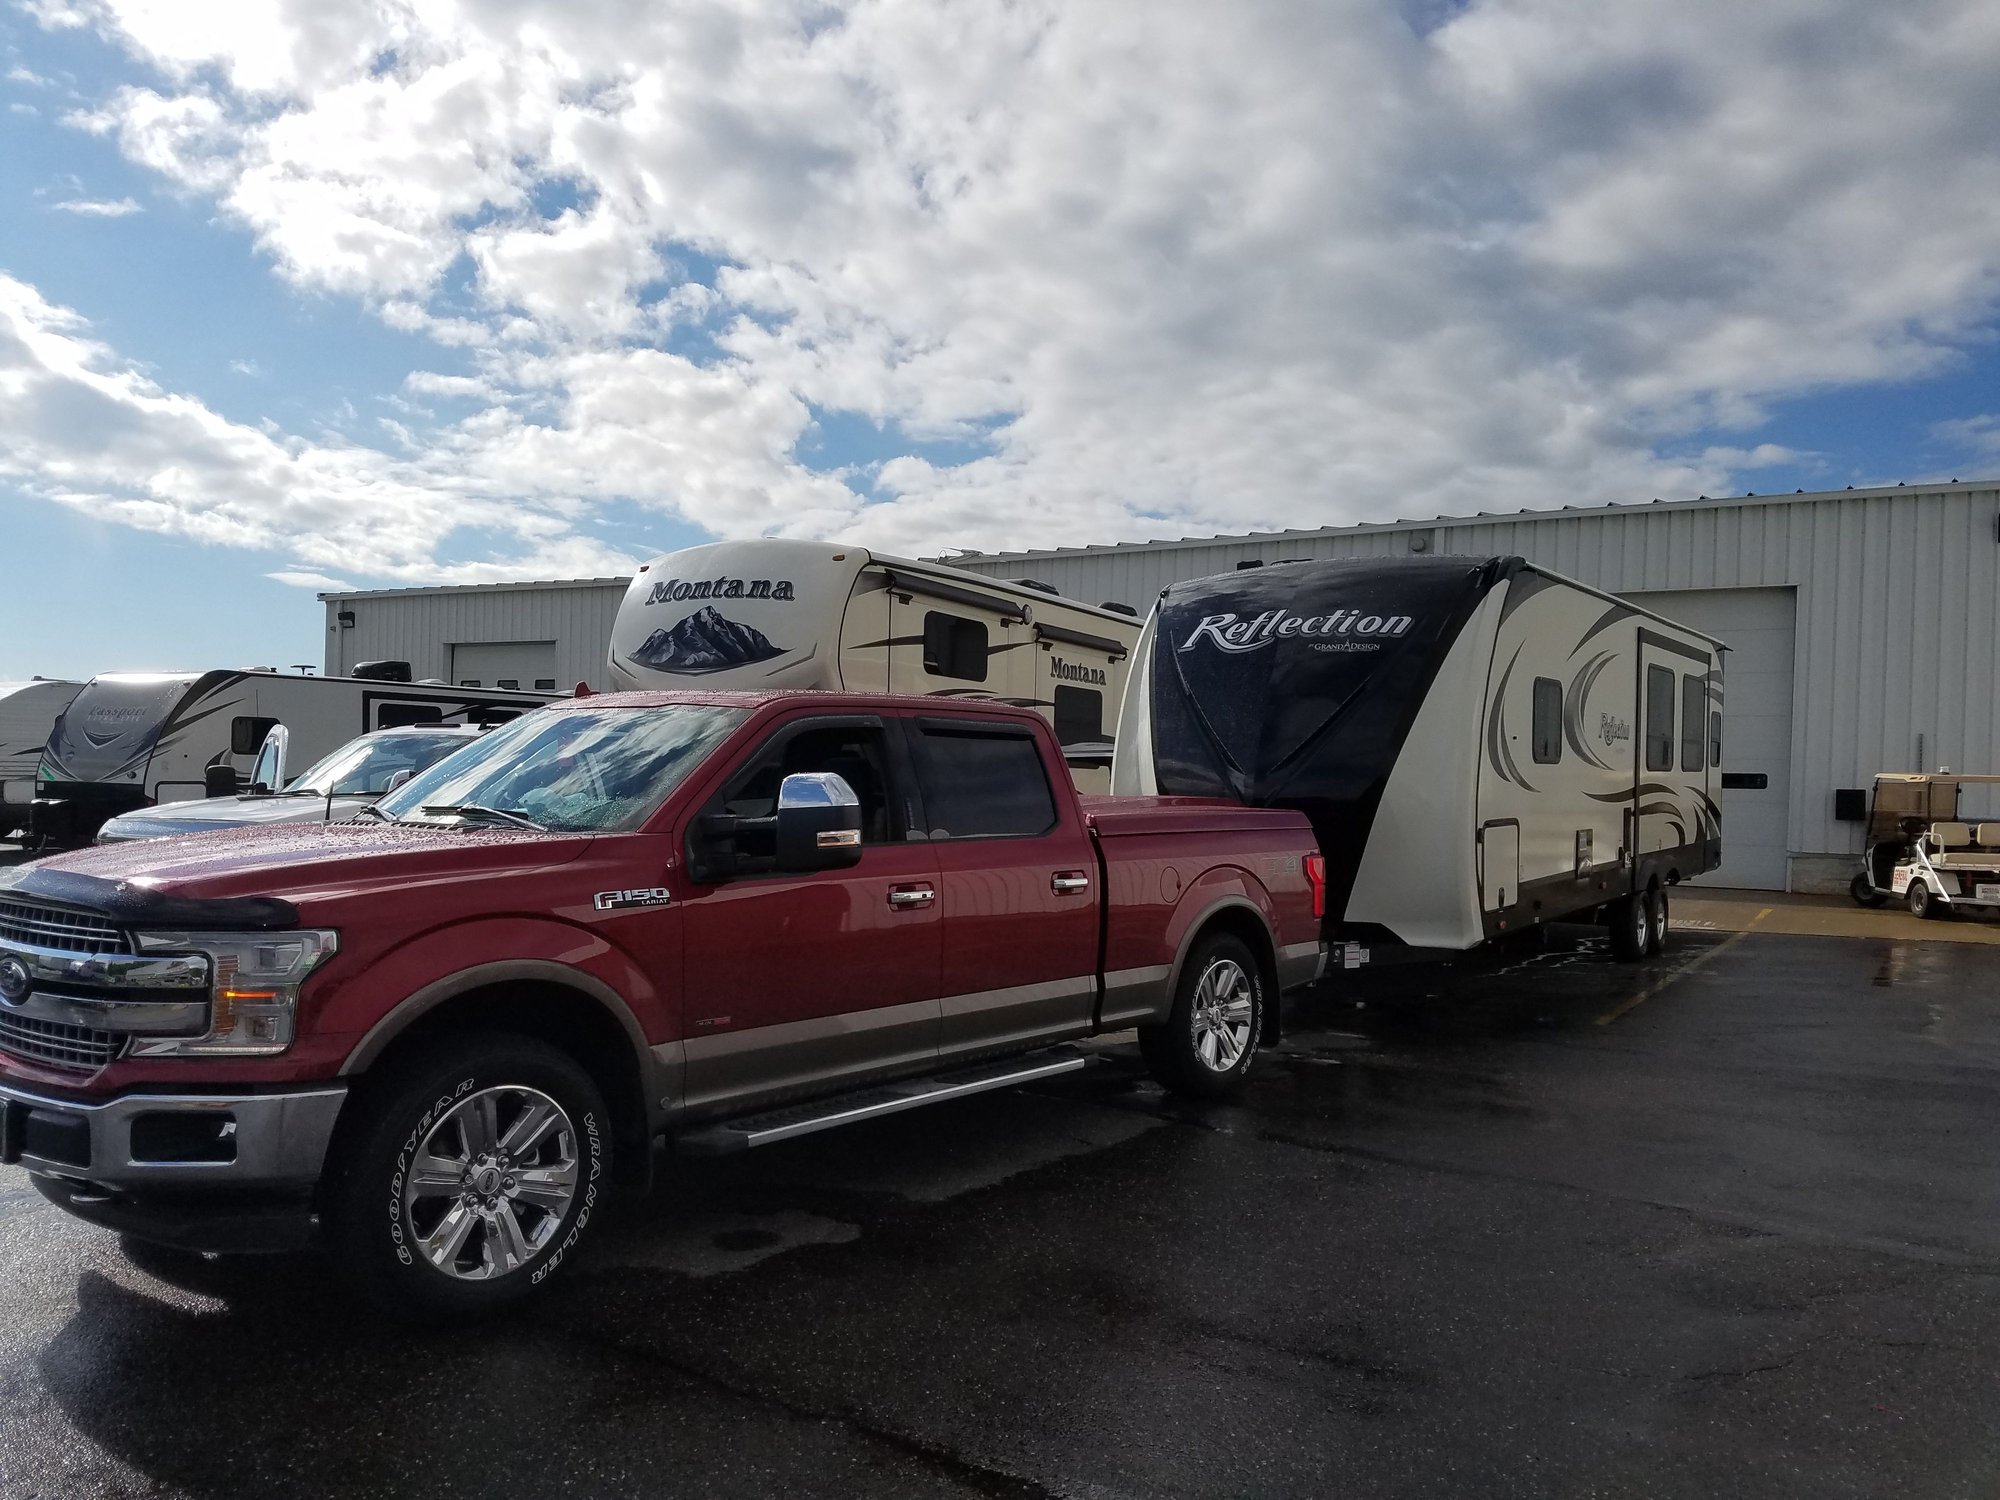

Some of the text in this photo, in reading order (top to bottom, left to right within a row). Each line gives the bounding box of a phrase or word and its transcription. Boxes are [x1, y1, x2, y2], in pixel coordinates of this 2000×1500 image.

[645, 576, 795, 606] Montana
[1177, 608, 1415, 654] Reflection
[1314, 642, 1344, 651] GRAND
[1350, 642, 1380, 651] DESIGN
[1050, 656, 1106, 686] Montana
[389, 1078, 474, 1265] GOODYEAR
[531, 1112, 601, 1284] WRANGLER
